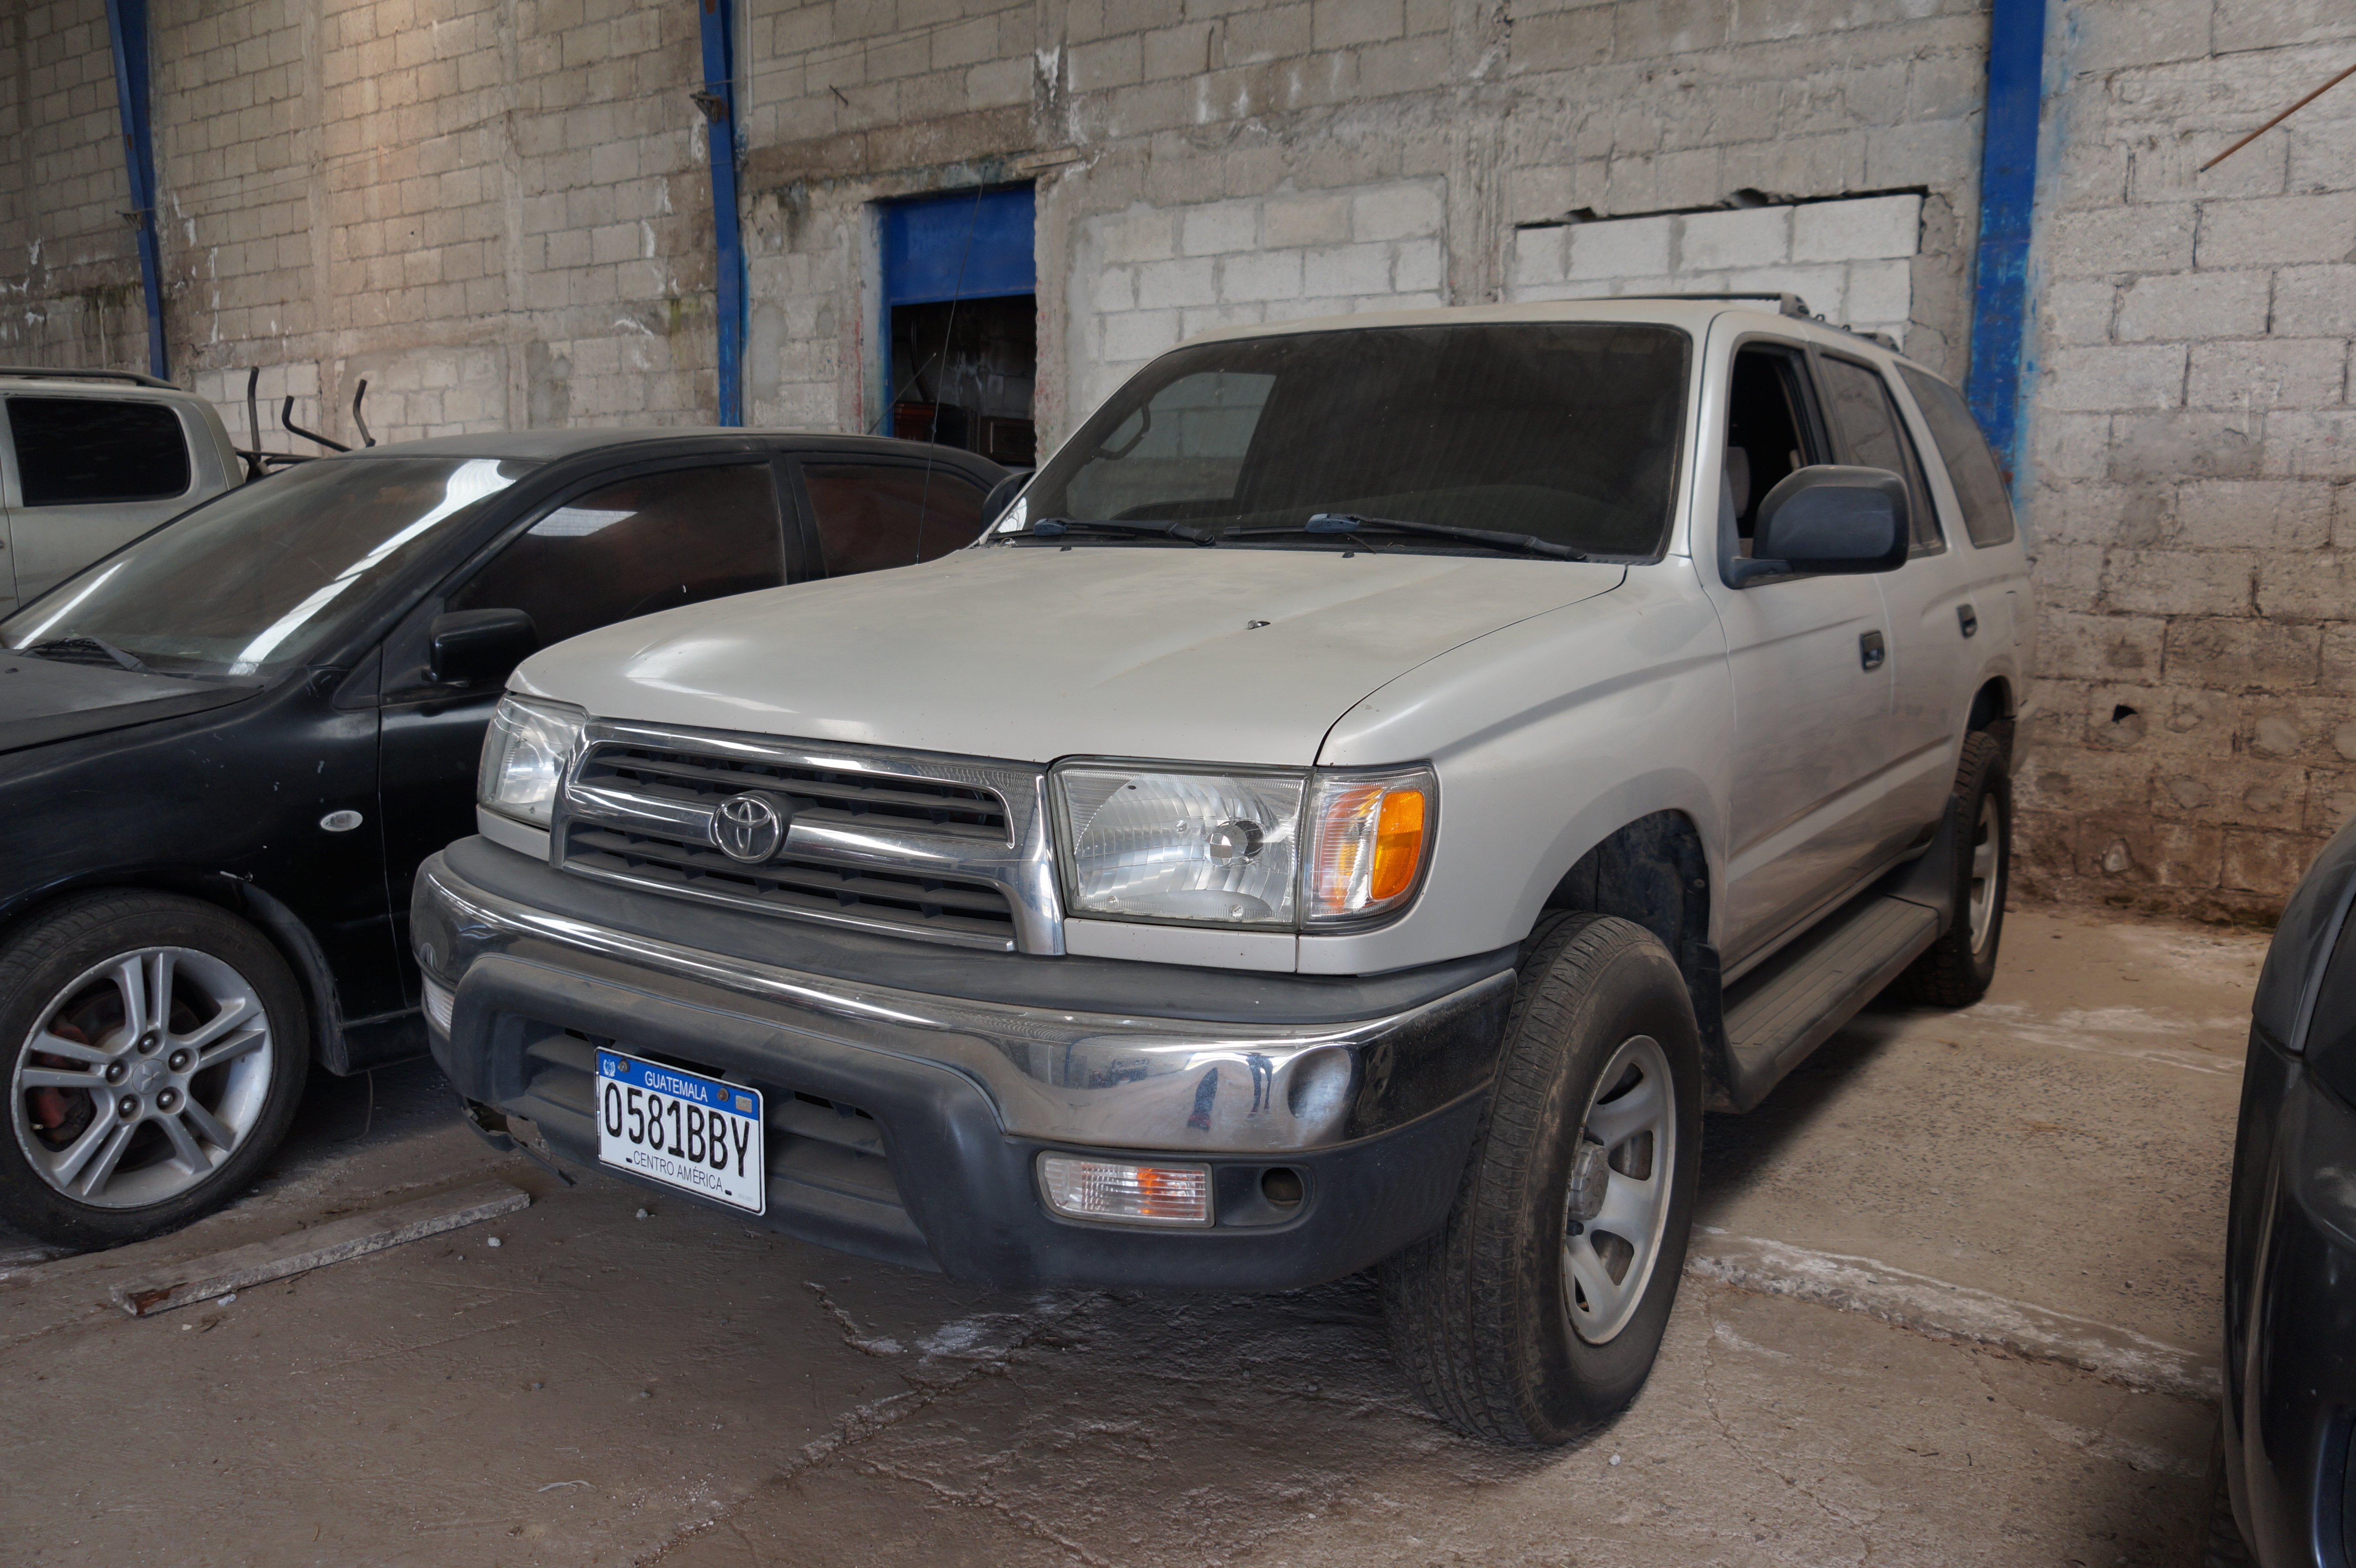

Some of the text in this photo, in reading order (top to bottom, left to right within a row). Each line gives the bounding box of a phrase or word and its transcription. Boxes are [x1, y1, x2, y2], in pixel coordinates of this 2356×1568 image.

[645, 1071, 708, 1102] GUATEMALA
[605, 1083, 750, 1177] 0581BBY
[633, 1151, 723, 1192] CENTRO AMÉRICA
